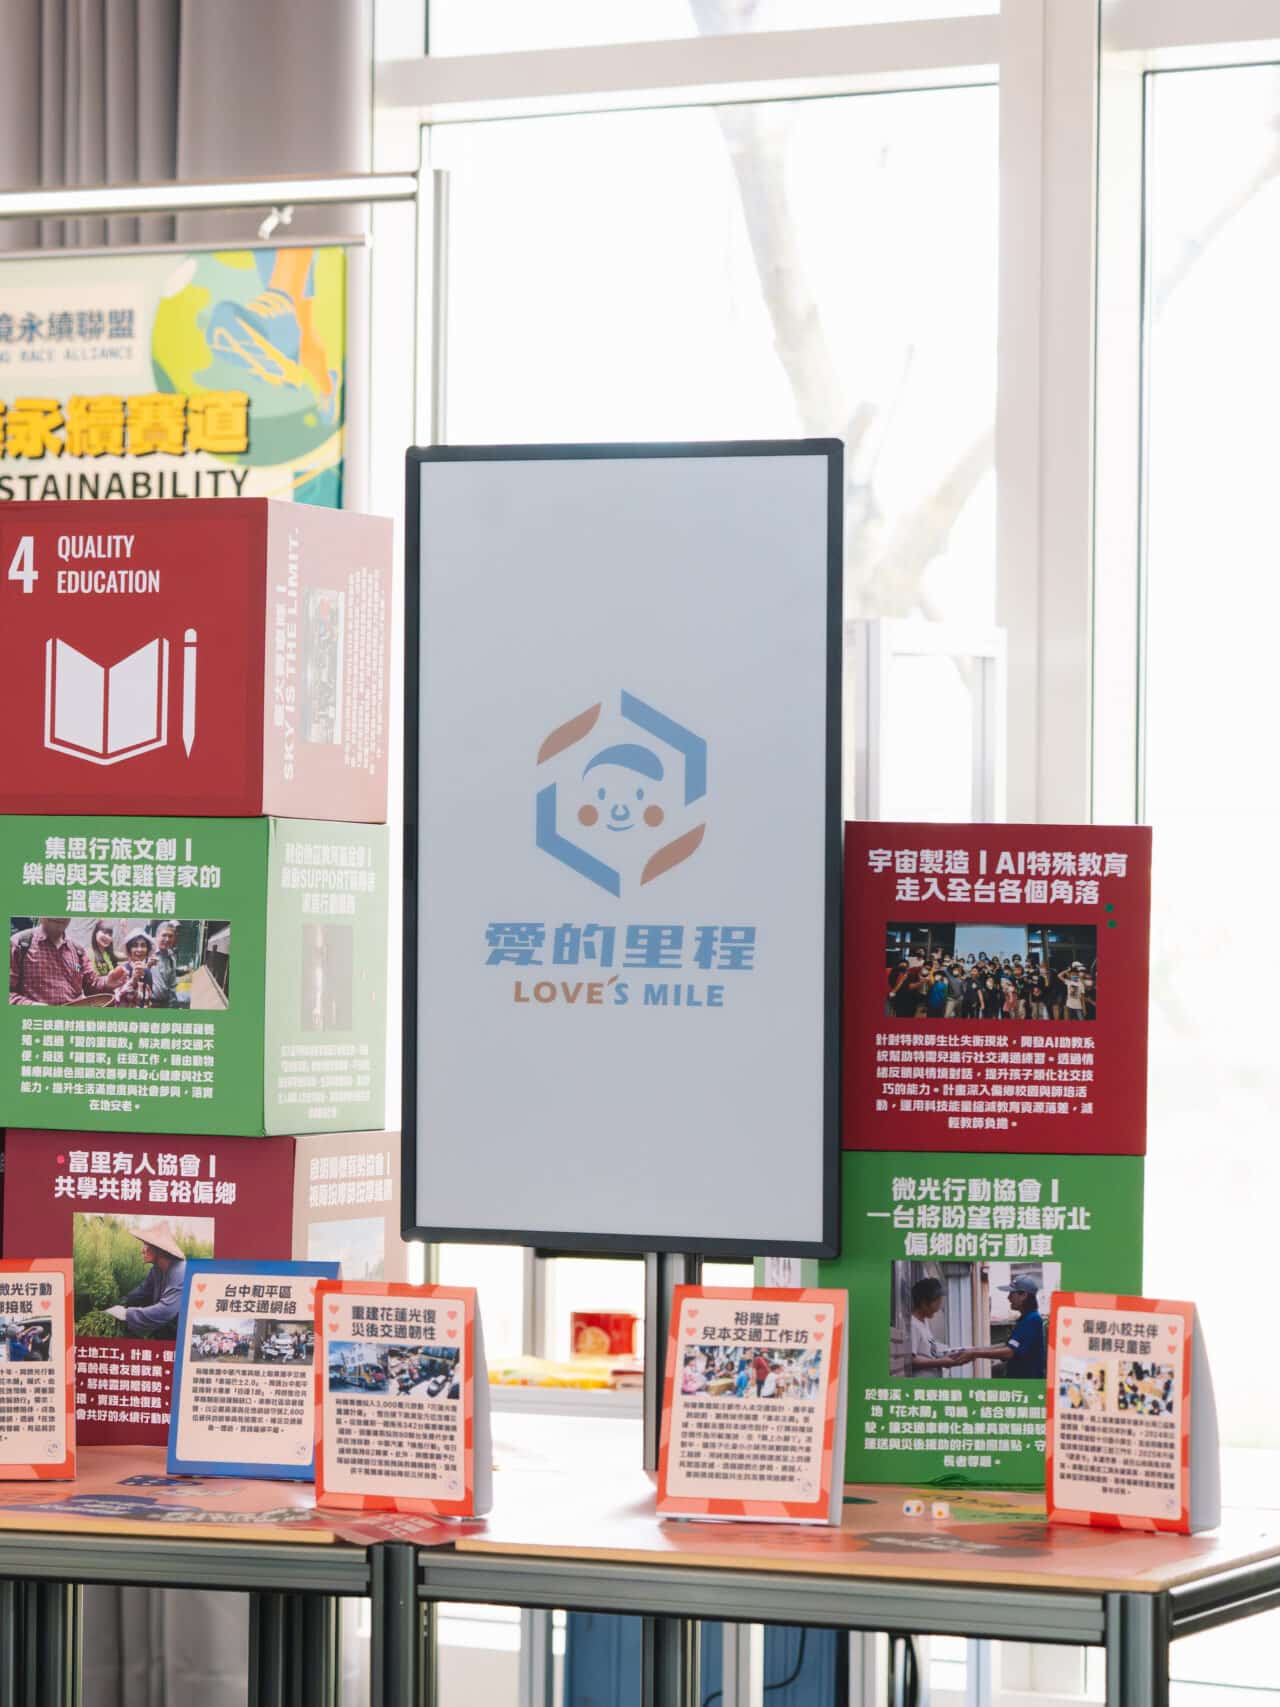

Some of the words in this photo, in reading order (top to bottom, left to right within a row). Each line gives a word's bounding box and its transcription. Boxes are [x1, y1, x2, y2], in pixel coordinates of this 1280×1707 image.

[57, 535, 135, 562] QUALITY
[8, 536, 39, 593] 4
[57, 570, 160, 593] EDUCATION
[286, 622, 297, 674] THE
[285, 687, 296, 713] IS
[283, 720, 297, 780] SKY
[22, 863, 220, 888] 樂齡與天使雞管家的
[66, 890, 176, 914] 溫馨接送情
[895, 877, 1100, 905] 走入全台各個角落
[484, 921, 757, 971] 愛的里程
[643, 983, 725, 1007] MILE
[54, 1176, 141, 1201] 共學共耕
[148, 1180, 237, 1205] 富裕偏鄉
[867, 1205, 1090, 1231] 一台將盼望帶進新北
[905, 1232, 1054, 1258] 偏鄉的行動車
[225, 1284, 292, 1298] 台中和平區
[216, 1299, 296, 1314] 彈性交通網絡
[352, 1306, 436, 1324] 重建花蓮光復
[352, 1322, 435, 1340] 災後交通韌性
[702, 1326, 808, 1343] 兒本交通工作坊
[1083, 1320, 1158, 1339] 偏鄉小校共伴
